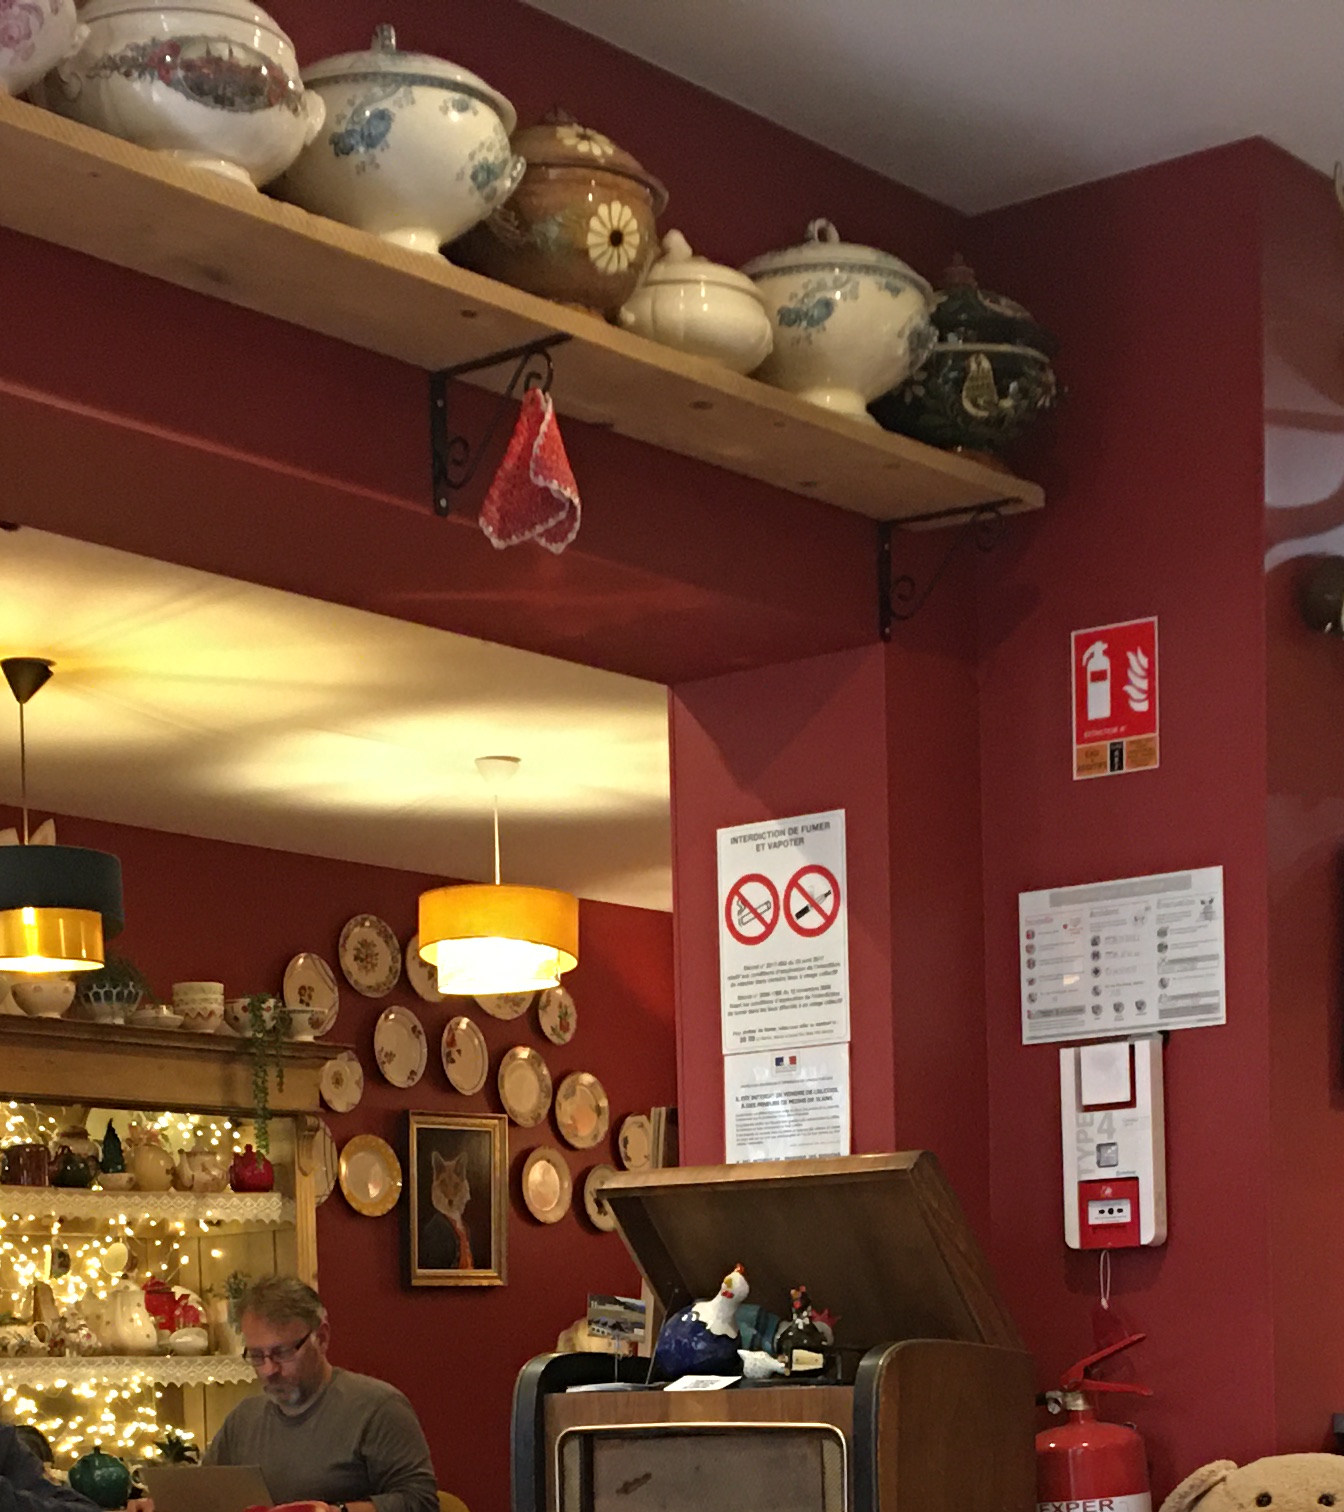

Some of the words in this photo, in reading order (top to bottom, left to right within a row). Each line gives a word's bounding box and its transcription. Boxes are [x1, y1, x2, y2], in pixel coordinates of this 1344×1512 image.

[730, 827, 786, 845] INTERDICTION
[787, 826, 799, 837] DE
[801, 821, 831, 836] FUMER
[756, 843, 765, 852] ET
[768, 837, 805, 850] VAPOTER
[1076, 1112, 1095, 1178] TYPE
[1097, 1112, 1116, 1140] 4
